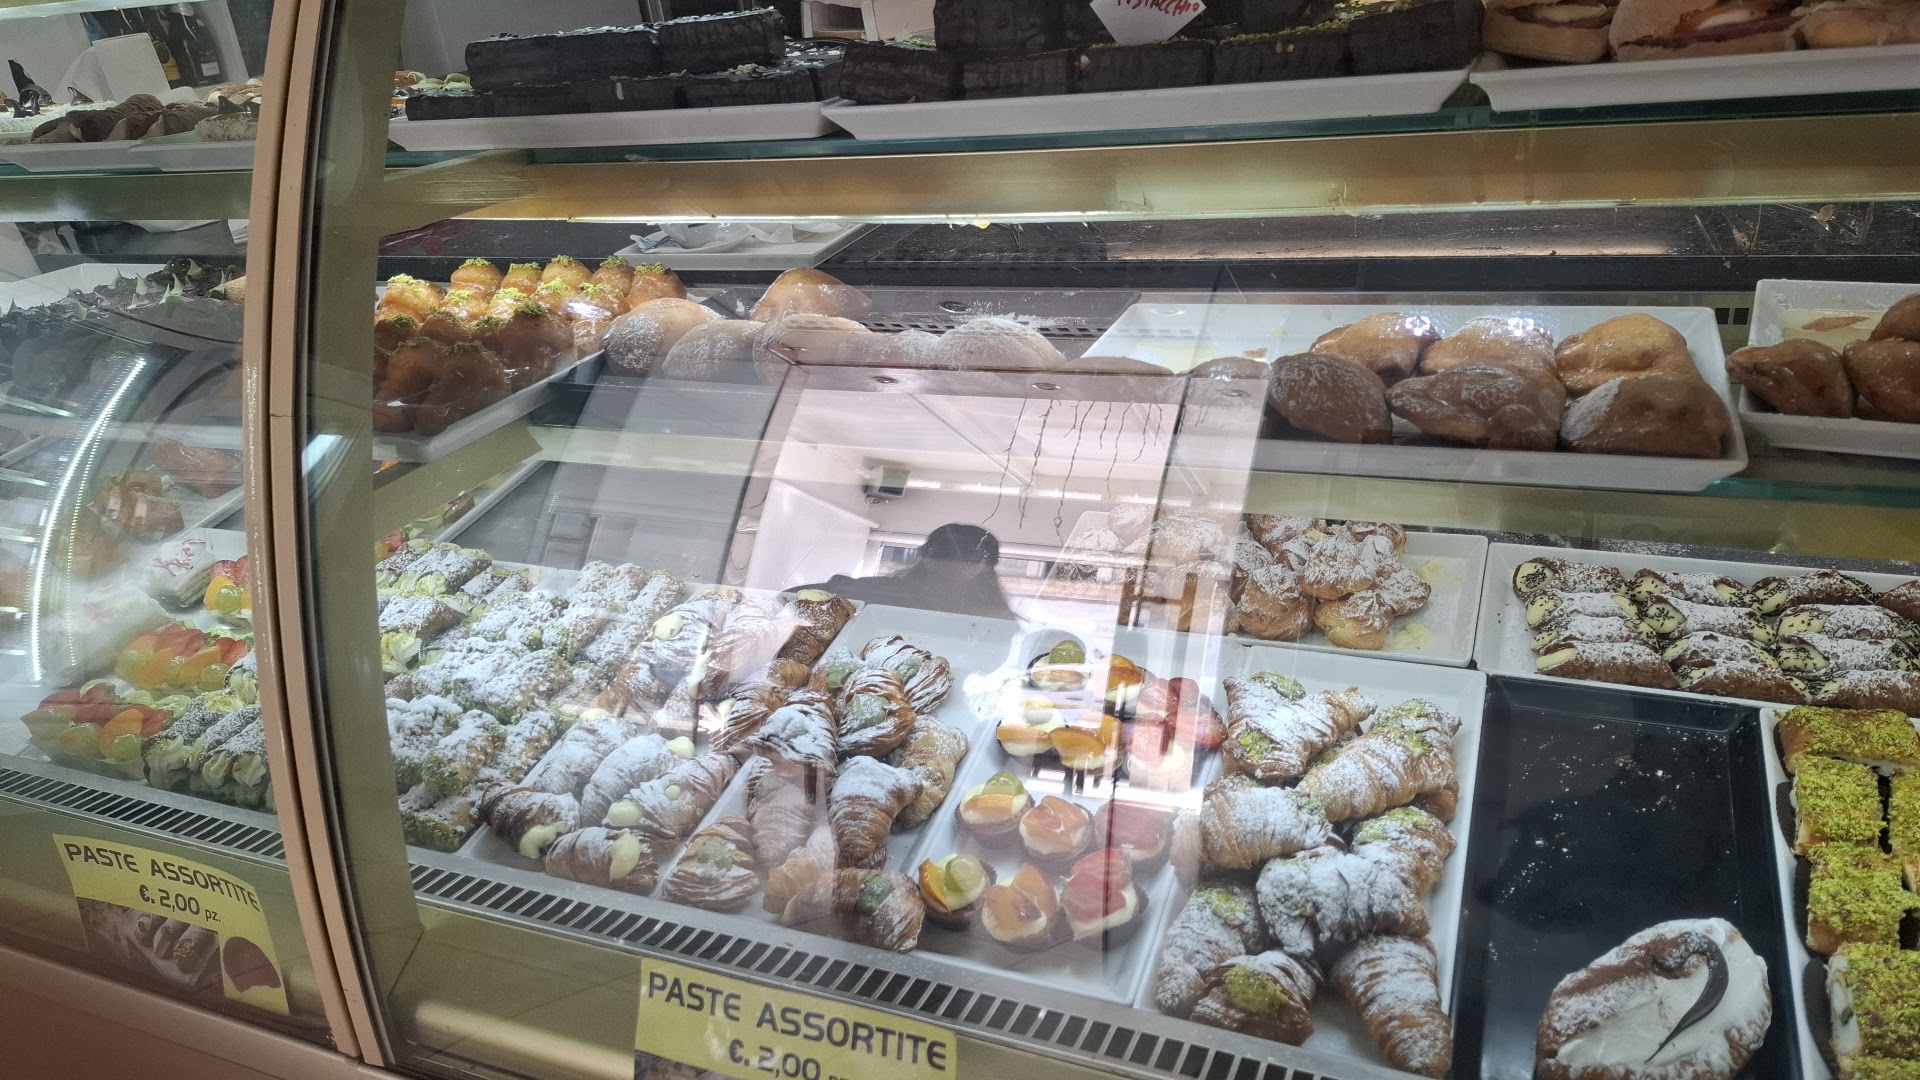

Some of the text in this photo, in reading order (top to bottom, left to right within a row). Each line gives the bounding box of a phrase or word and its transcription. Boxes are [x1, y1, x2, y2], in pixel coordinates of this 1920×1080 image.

[63, 842, 260, 912] PASTE ASSORTITE
[205, 909, 221, 922] pz.
[649, 971, 946, 1071] PASTE ASSORTITE
